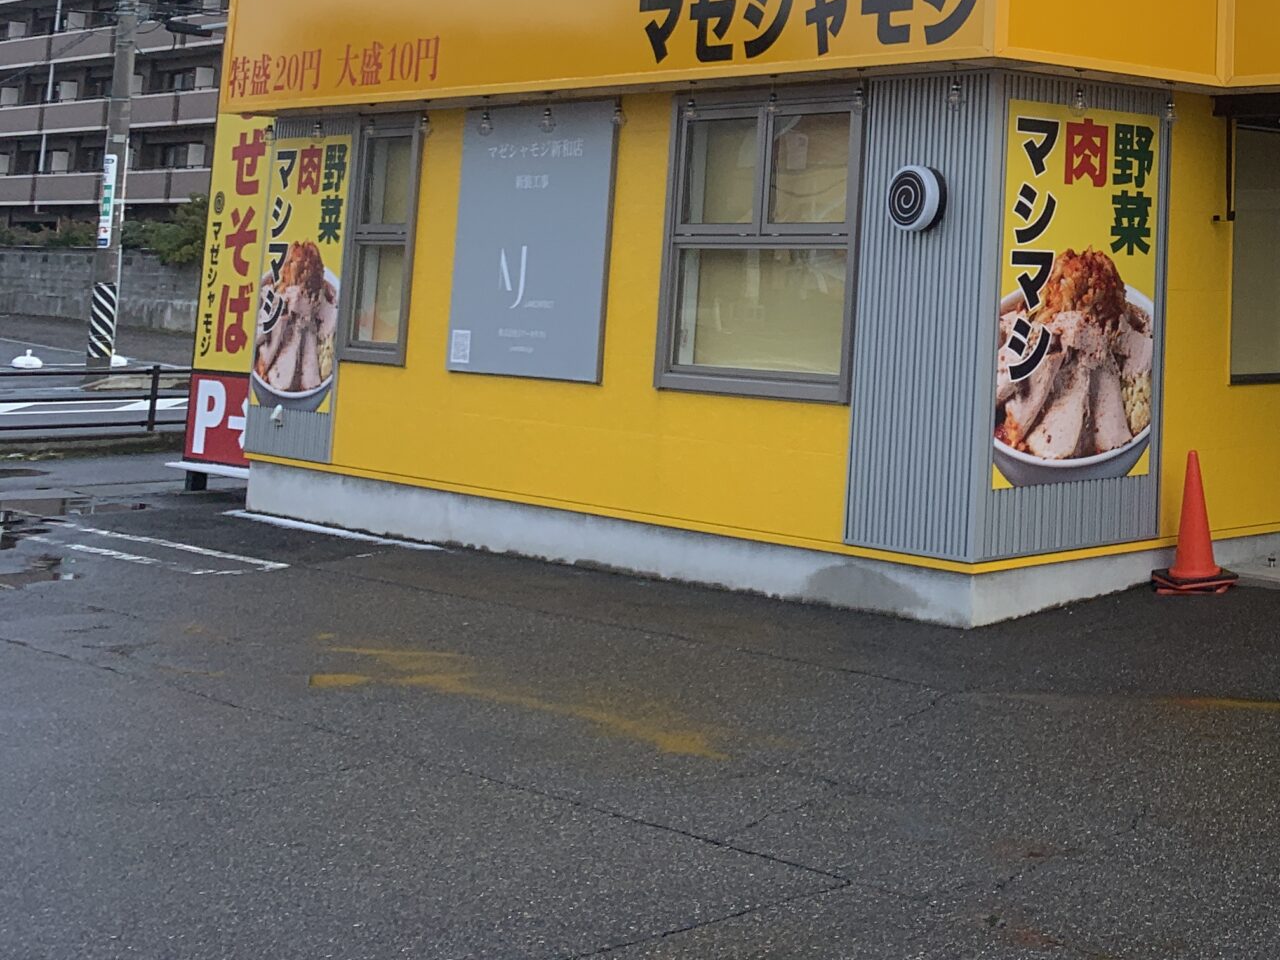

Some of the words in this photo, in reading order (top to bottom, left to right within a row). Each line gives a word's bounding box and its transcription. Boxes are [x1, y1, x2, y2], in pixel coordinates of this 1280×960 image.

[229, 47, 322, 98] 特盛20円
[335, 35, 440, 87] 大盛10円
[297, 144, 323, 195] 肉
[318, 143, 348, 245] 野菜
[1064, 118, 1109, 188] 肉
[1109, 123, 1154, 256] 野菜
[200, 221, 222, 357] マゼシャモジ
[215, 112, 266, 355] ぜそば
[262, 149, 298, 334] マシマシ
[1008, 116, 1061, 383] マシマシ
[192, 378, 227, 454] P
